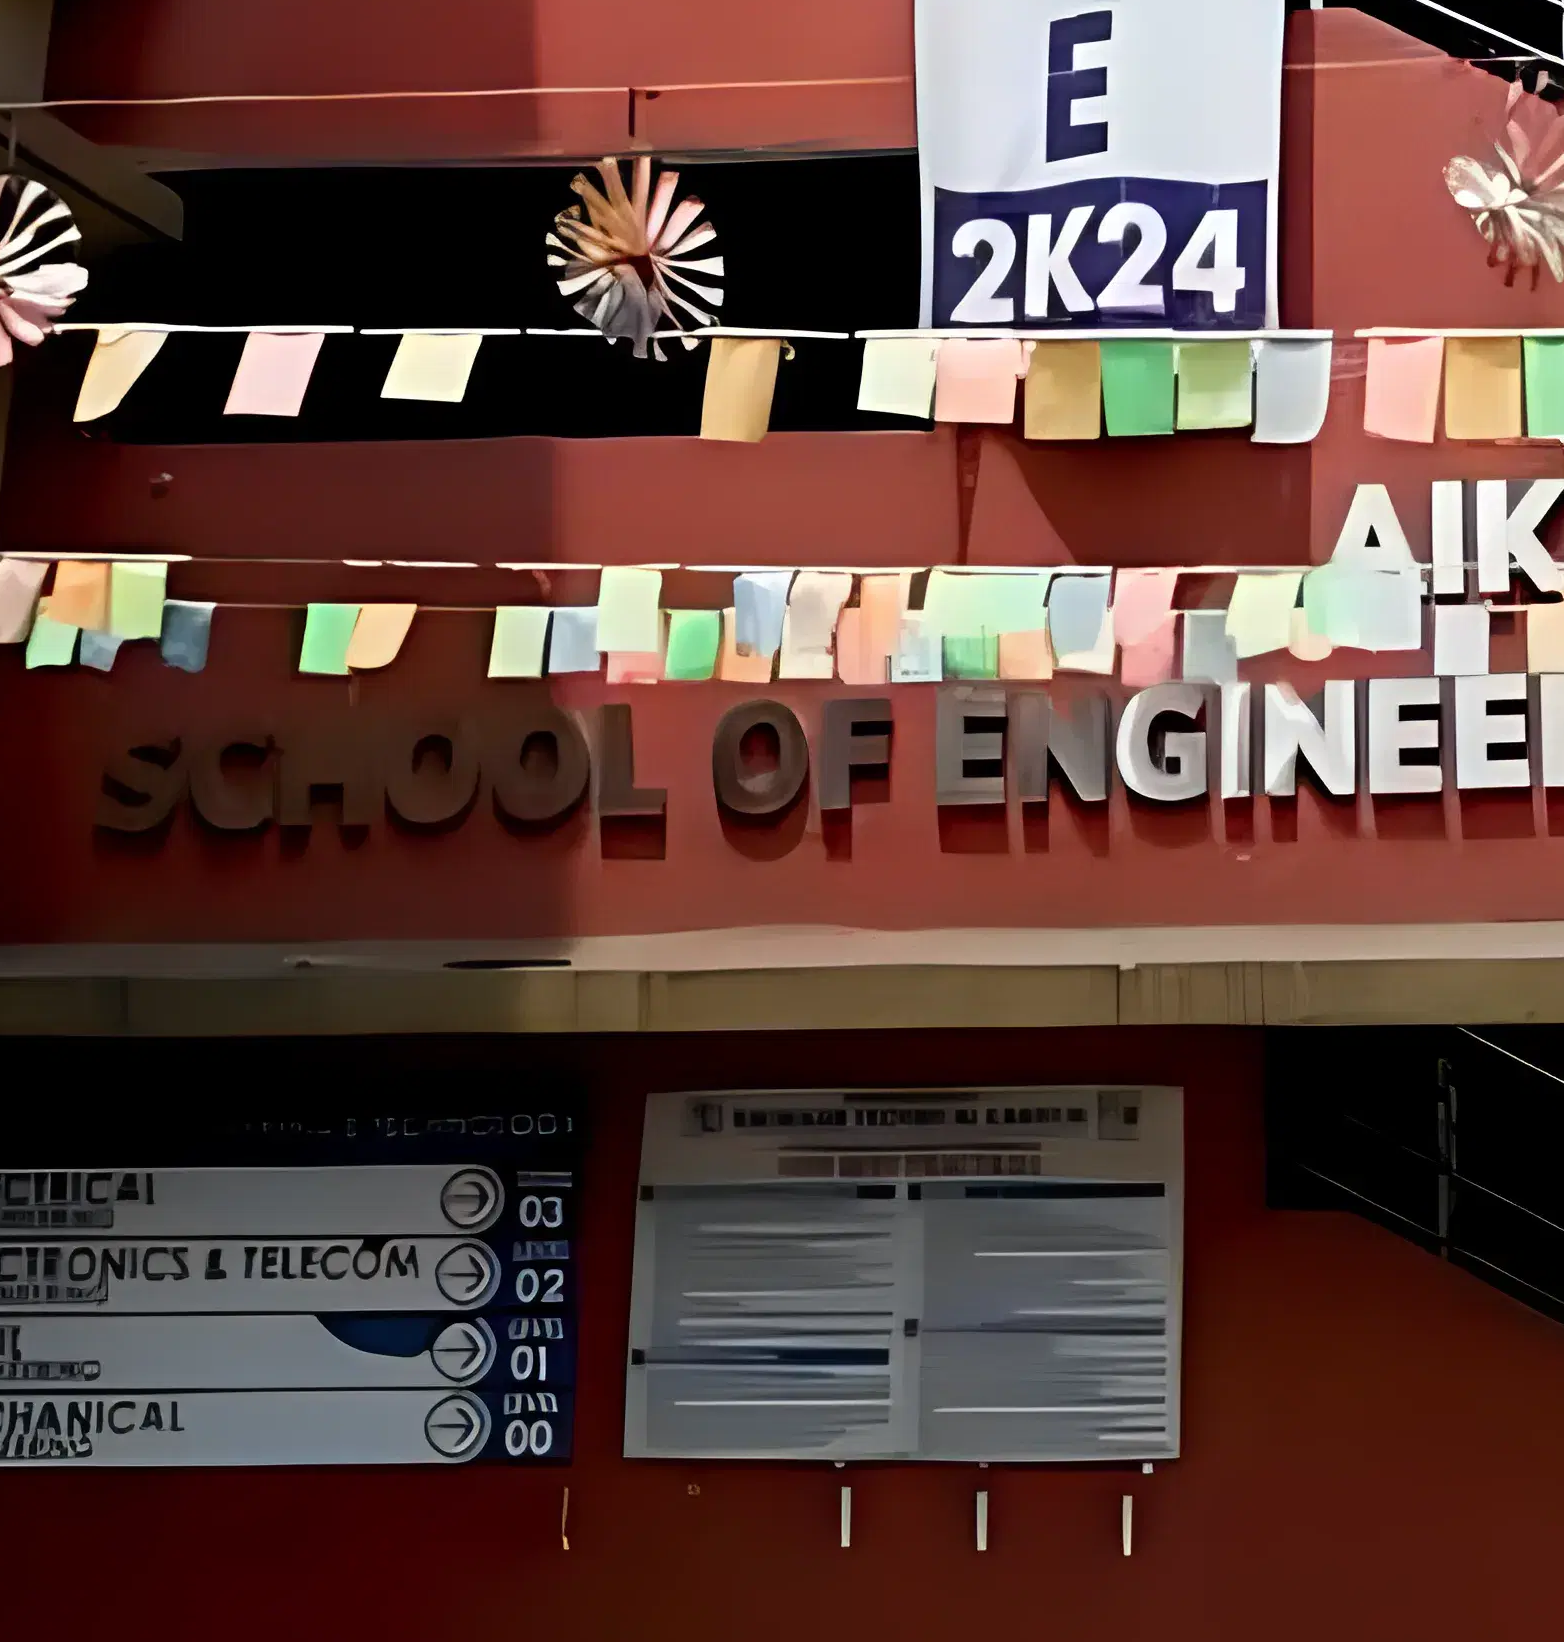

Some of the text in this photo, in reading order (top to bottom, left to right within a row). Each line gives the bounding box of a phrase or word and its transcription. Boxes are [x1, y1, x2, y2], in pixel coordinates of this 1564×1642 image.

[949, 202, 1246, 324] 2K24
[96, 703, 668, 832] SCHOOL
[712, 698, 894, 817] OF
[518, 1195, 564, 1229] 03
[243, 1244, 420, 1281] TELECOM
[515, 1268, 565, 1304] 02
[510, 1344, 548, 1382] 01
[504, 1418, 554, 1457] 00
